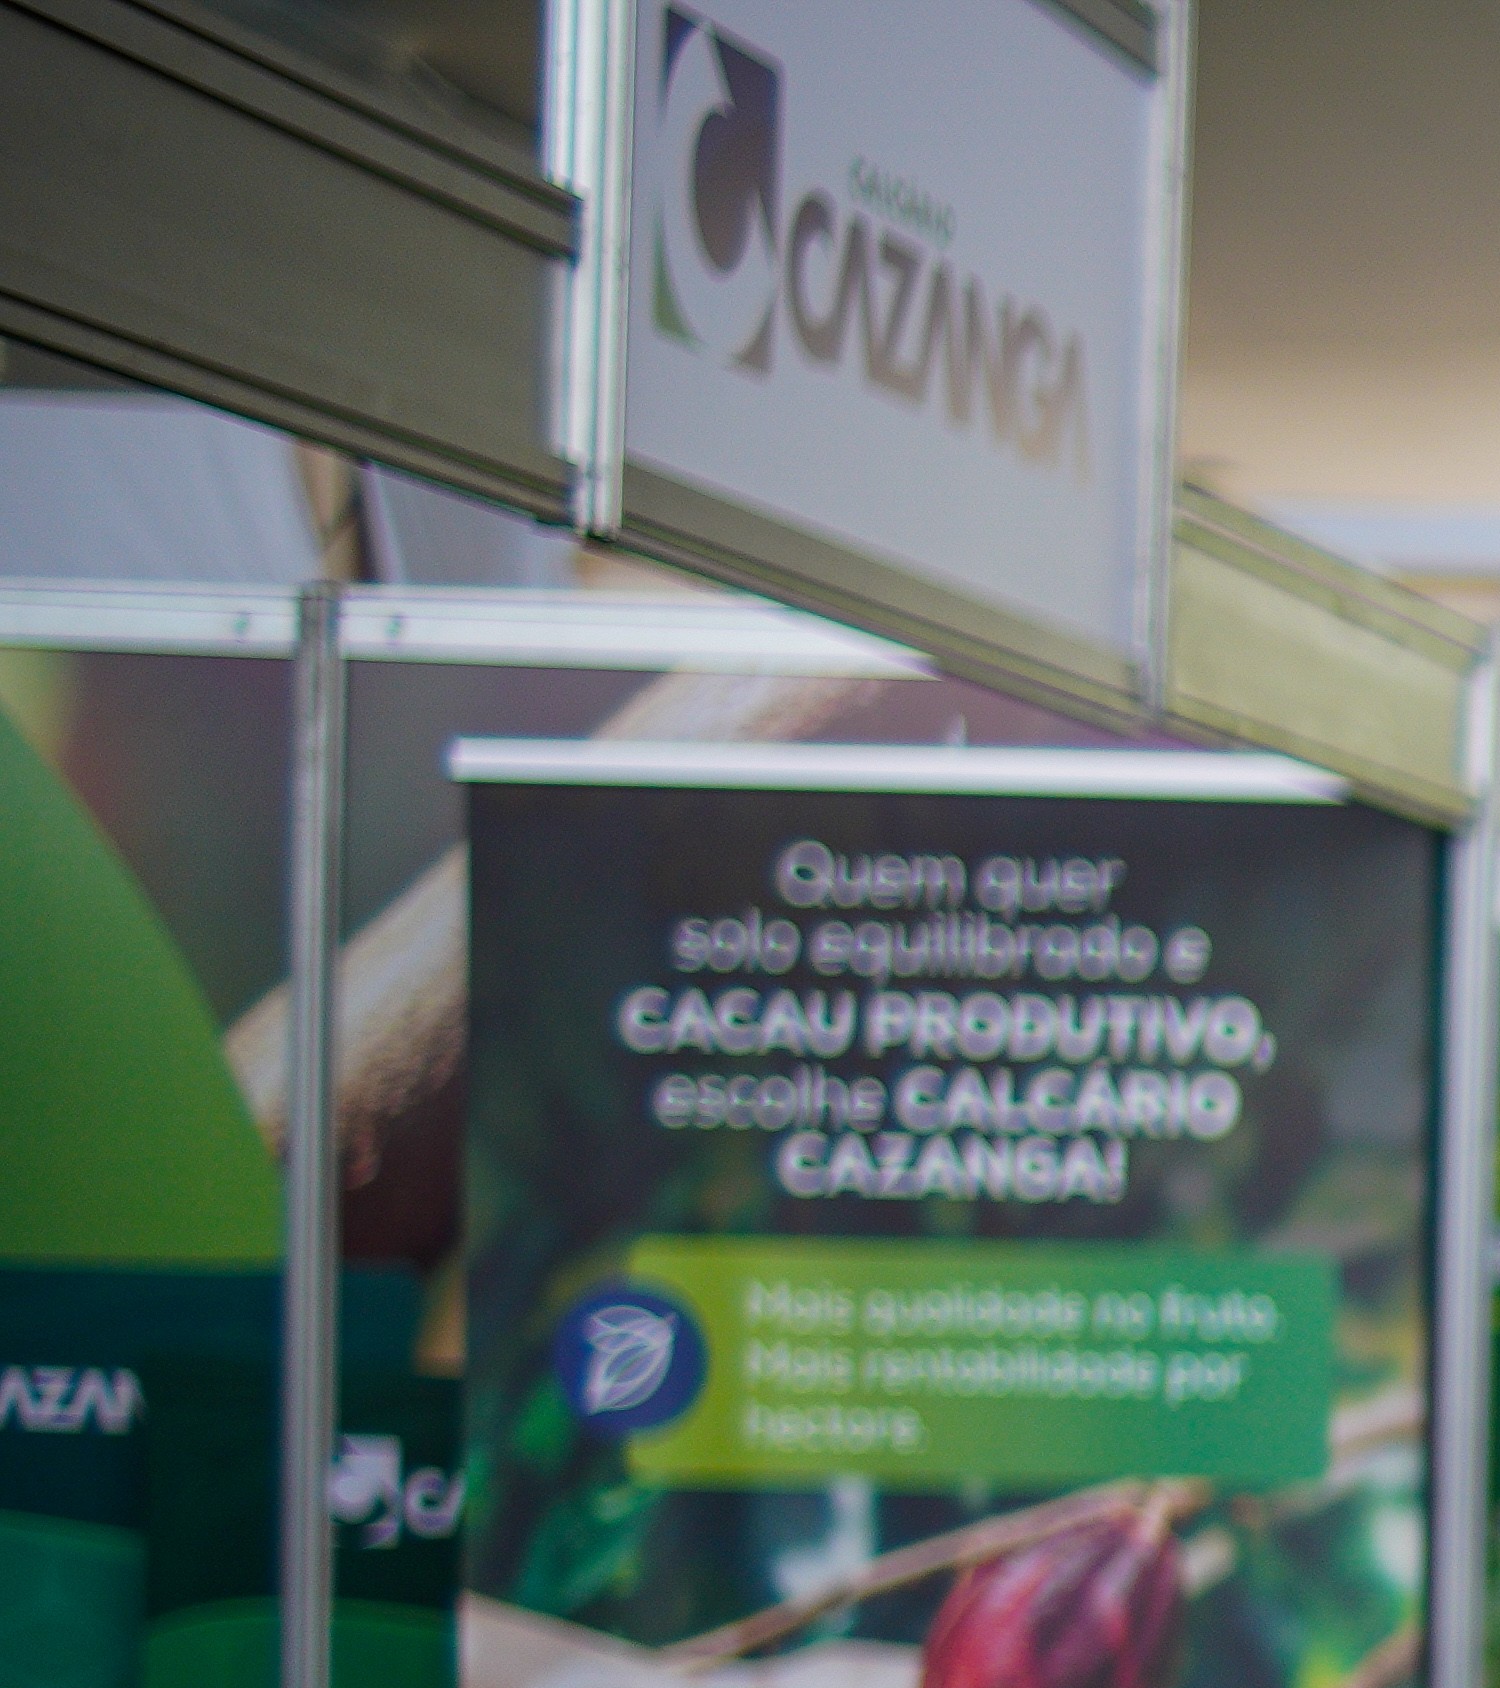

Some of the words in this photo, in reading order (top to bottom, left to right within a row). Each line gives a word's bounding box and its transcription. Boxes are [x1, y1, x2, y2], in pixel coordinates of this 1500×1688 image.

[776, 841, 967, 910] Quem
[974, 852, 1126, 920] quer
[672, 908, 801, 976] solo
[811, 912, 1160, 986] equilibrado
[1164, 924, 1213, 982] e
[617, 985, 859, 1060] CACAU
[862, 990, 1277, 1071] PRODUTIVO,
[652, 1062, 886, 1132] escolhe
[893, 1054, 1244, 1140] CALCÁRIO
[774, 1132, 1128, 1203] CAZANGA!
